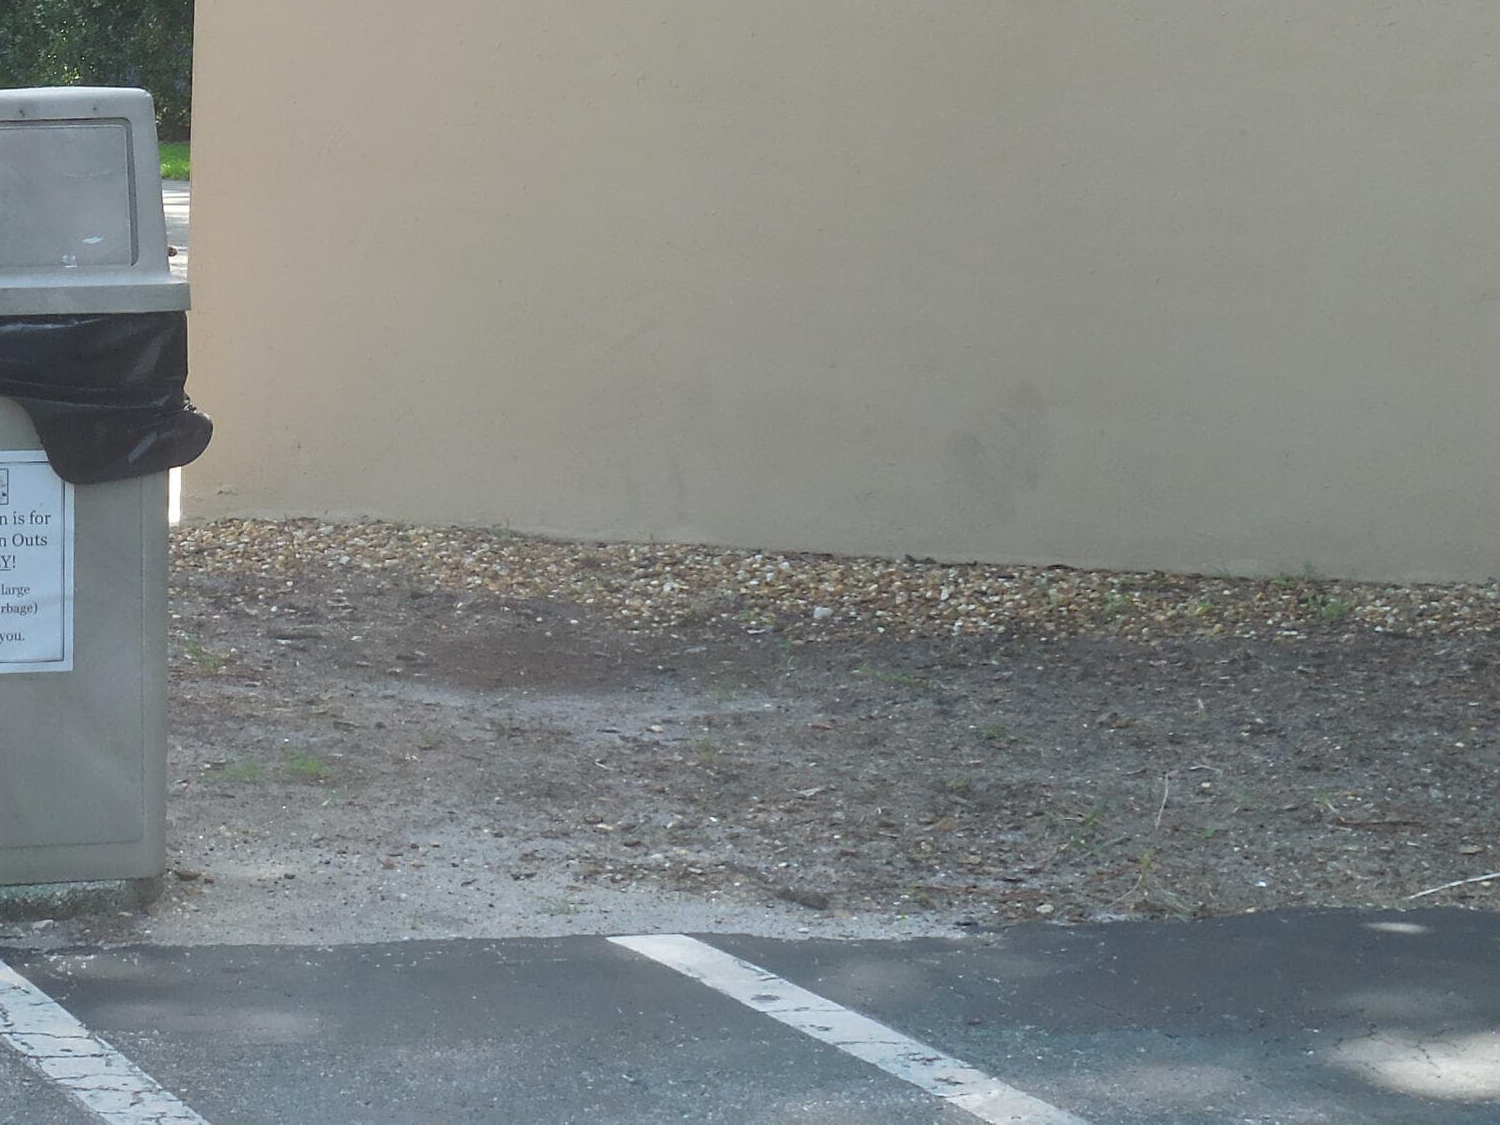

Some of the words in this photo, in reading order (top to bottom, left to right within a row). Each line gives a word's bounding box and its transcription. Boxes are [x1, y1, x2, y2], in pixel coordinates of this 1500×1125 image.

[13, 511, 25, 525] is
[29, 510, 51, 525] for
[12, 533, 48, 547] Outs
[1, 583, 31, 598] large
